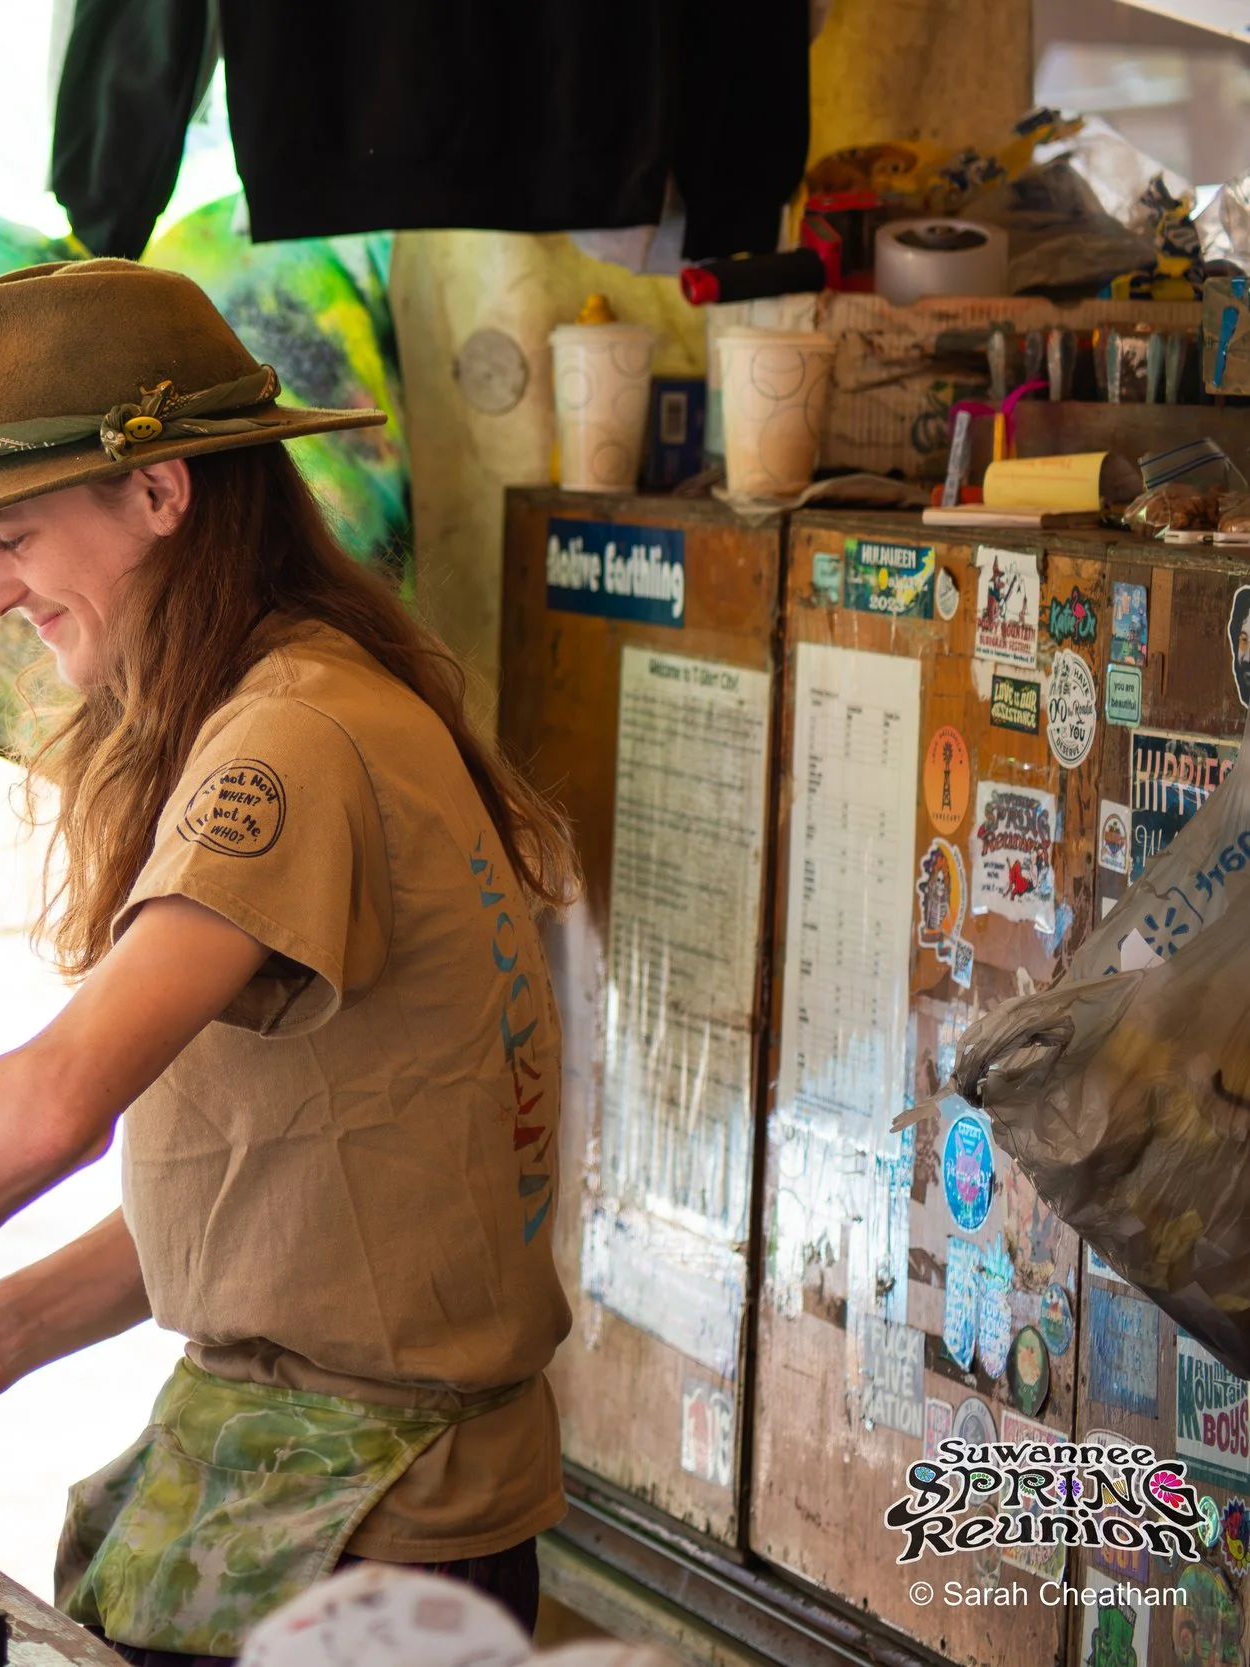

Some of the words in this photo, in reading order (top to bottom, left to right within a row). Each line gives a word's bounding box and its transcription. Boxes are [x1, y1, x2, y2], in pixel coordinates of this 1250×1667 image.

[546, 535, 601, 593] Native
[604, 541, 685, 619] Earthling
[1074, 666, 1091, 697] HAVE
[1114, 682, 1125, 694] you
[1125, 684, 1135, 693] are
[994, 680, 1014, 706] LOVE
[1111, 698, 1137, 712] beautiful
[1069, 723, 1086, 742] YOU
[1055, 737, 1080, 758] DESERVE
[218, 788, 262, 807] WHEN?
[213, 807, 240, 822] Not
[210, 825, 246, 845] WHO?
[874, 1355, 914, 1398] LIVE
